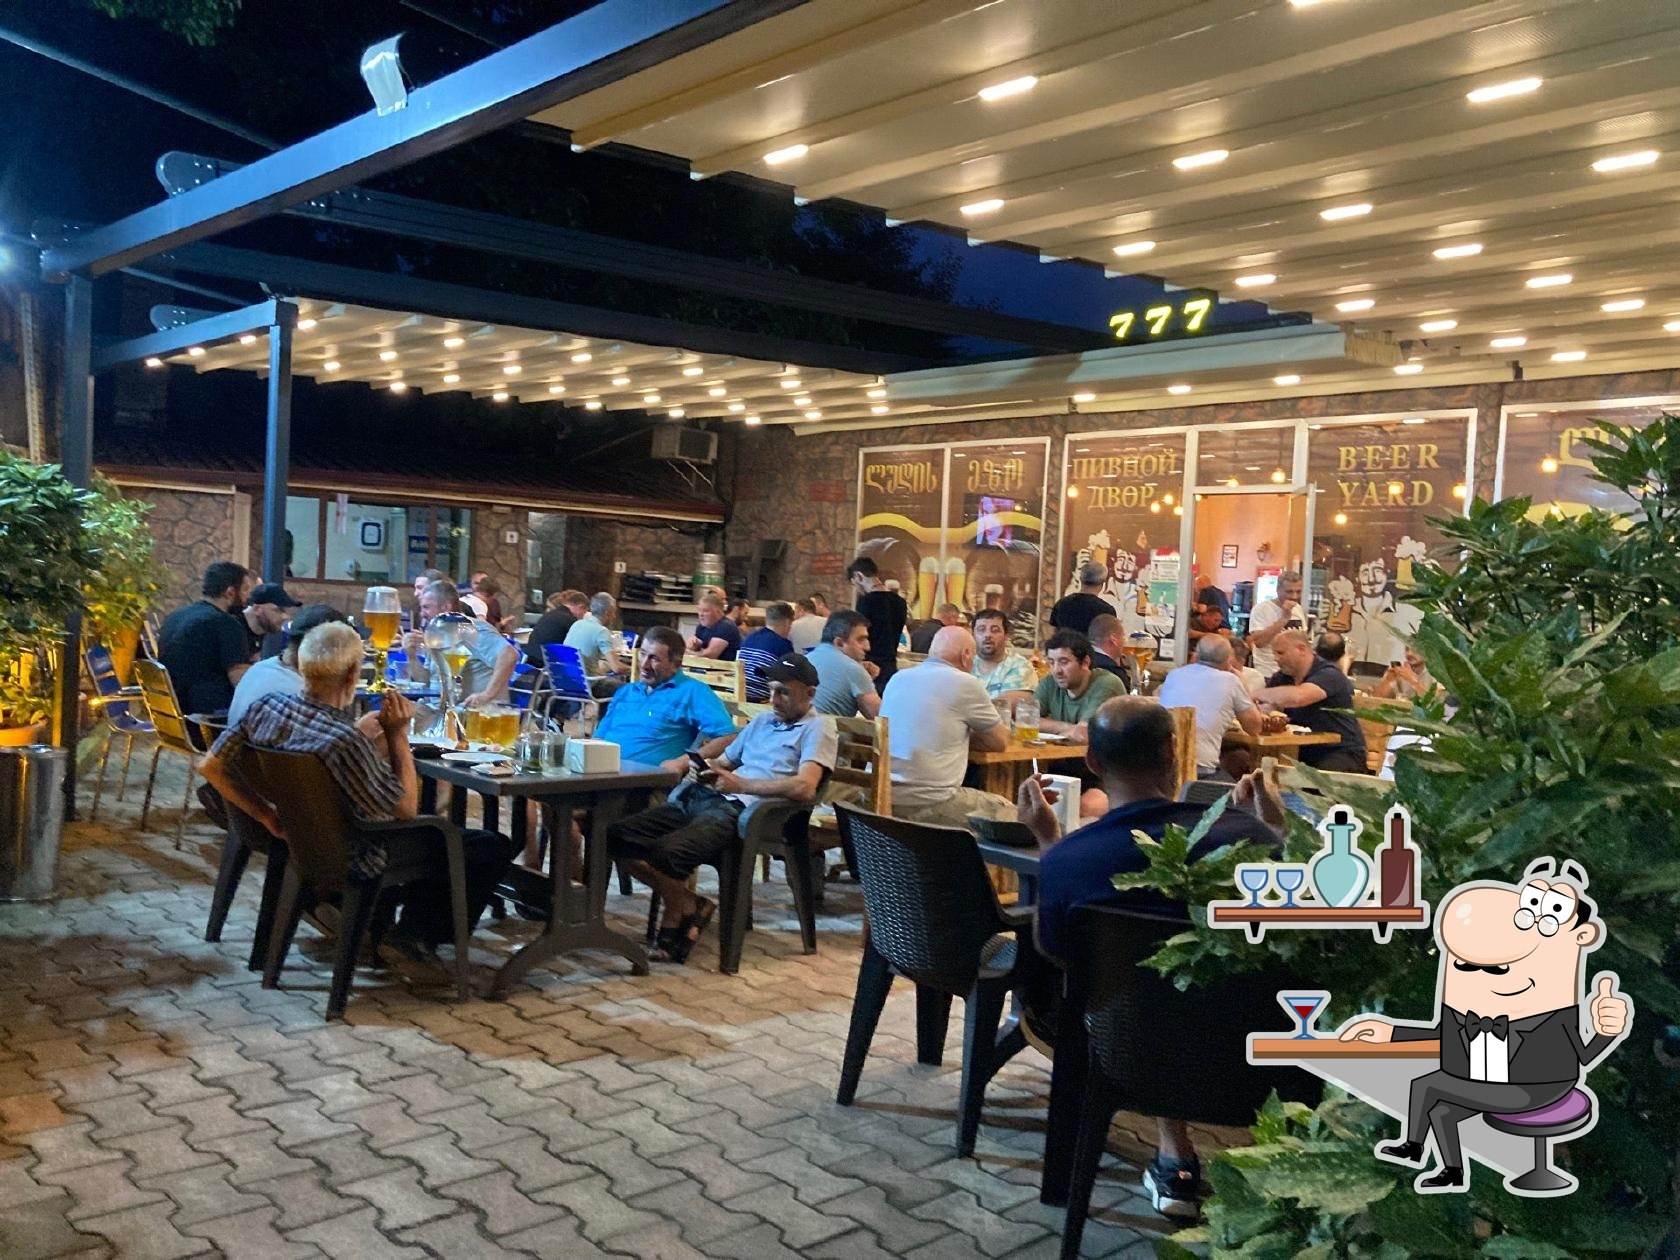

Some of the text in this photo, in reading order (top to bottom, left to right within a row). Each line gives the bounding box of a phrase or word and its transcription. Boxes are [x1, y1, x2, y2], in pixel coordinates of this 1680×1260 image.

[1109, 298, 1211, 338] 777
[1071, 448, 1177, 479] ПИВНОЙ
[1337, 443, 1440, 471] BEER
[1087, 485, 1155, 513] ДВОР
[1338, 480, 1434, 507] YARD
